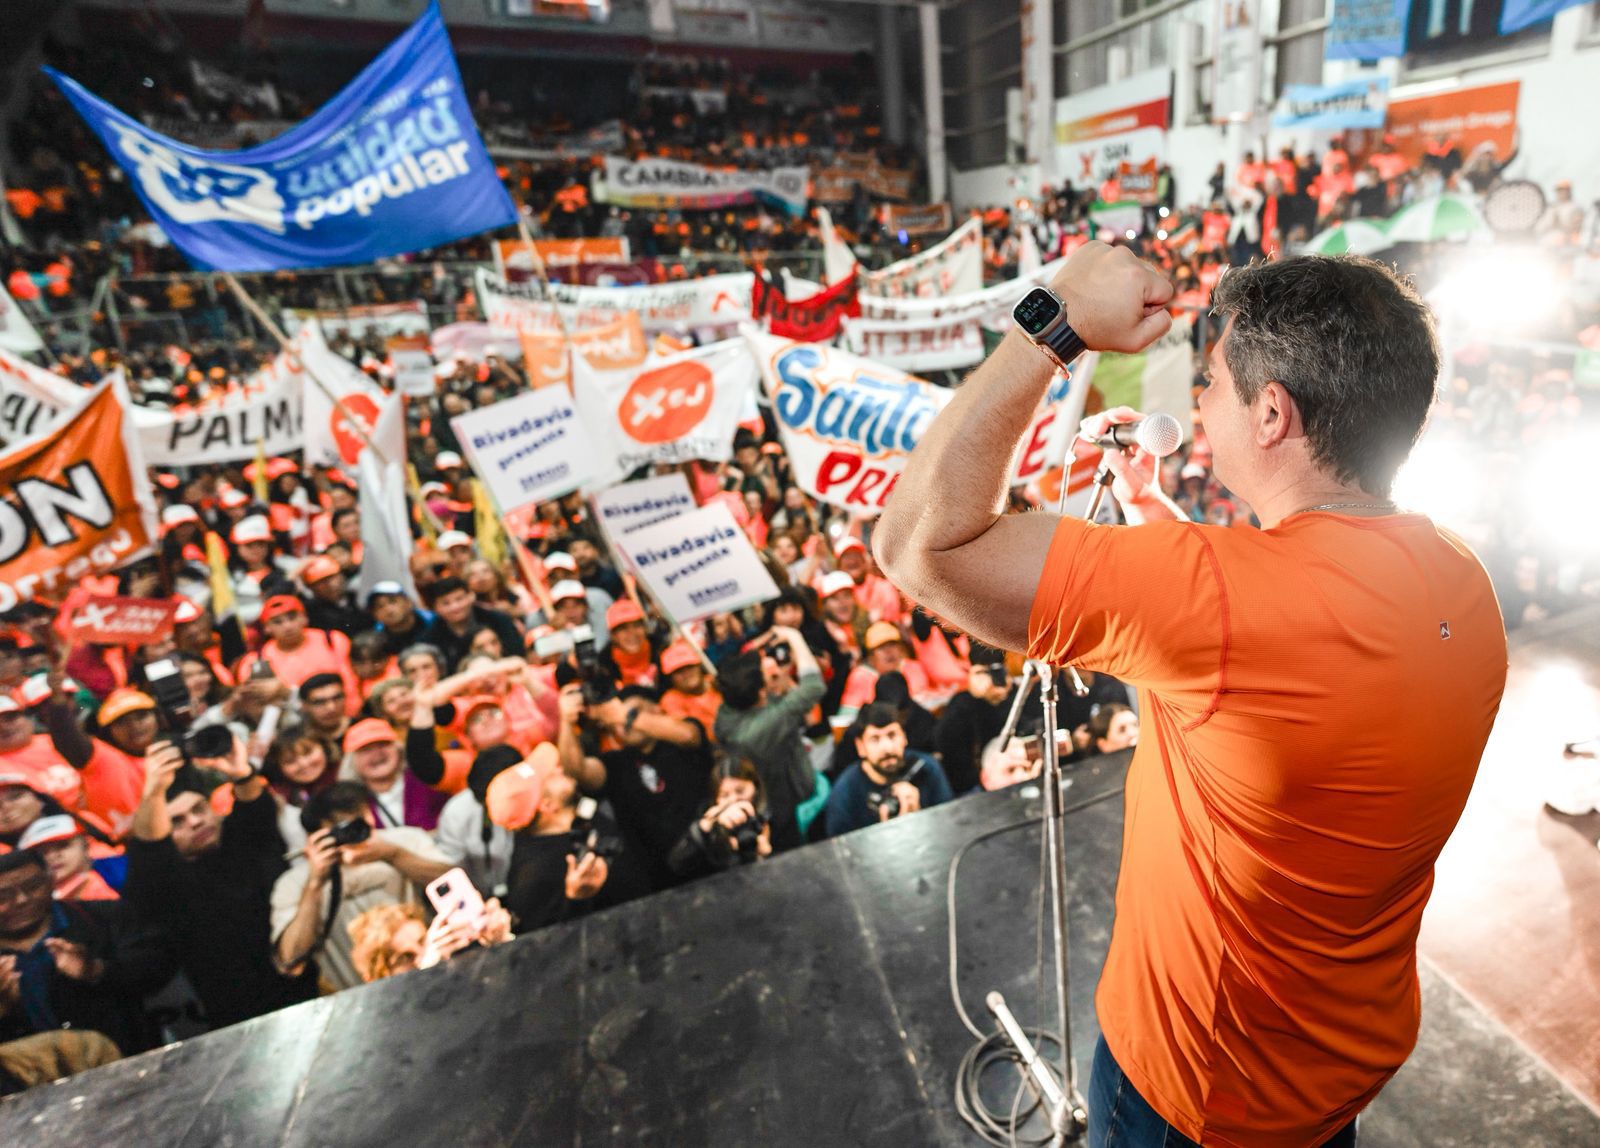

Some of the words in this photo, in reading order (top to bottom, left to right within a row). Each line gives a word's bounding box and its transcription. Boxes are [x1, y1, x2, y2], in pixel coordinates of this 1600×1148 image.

[288, 97, 462, 197] unidad
[294, 141, 470, 231] popular
[168, 399, 304, 450] PALM
[473, 406, 573, 449] Rivadavia
[499, 425, 565, 471] presente
[603, 493, 690, 518] Rivadavia
[635, 525, 737, 567] Rivadavia
[663, 547, 731, 587] presente
